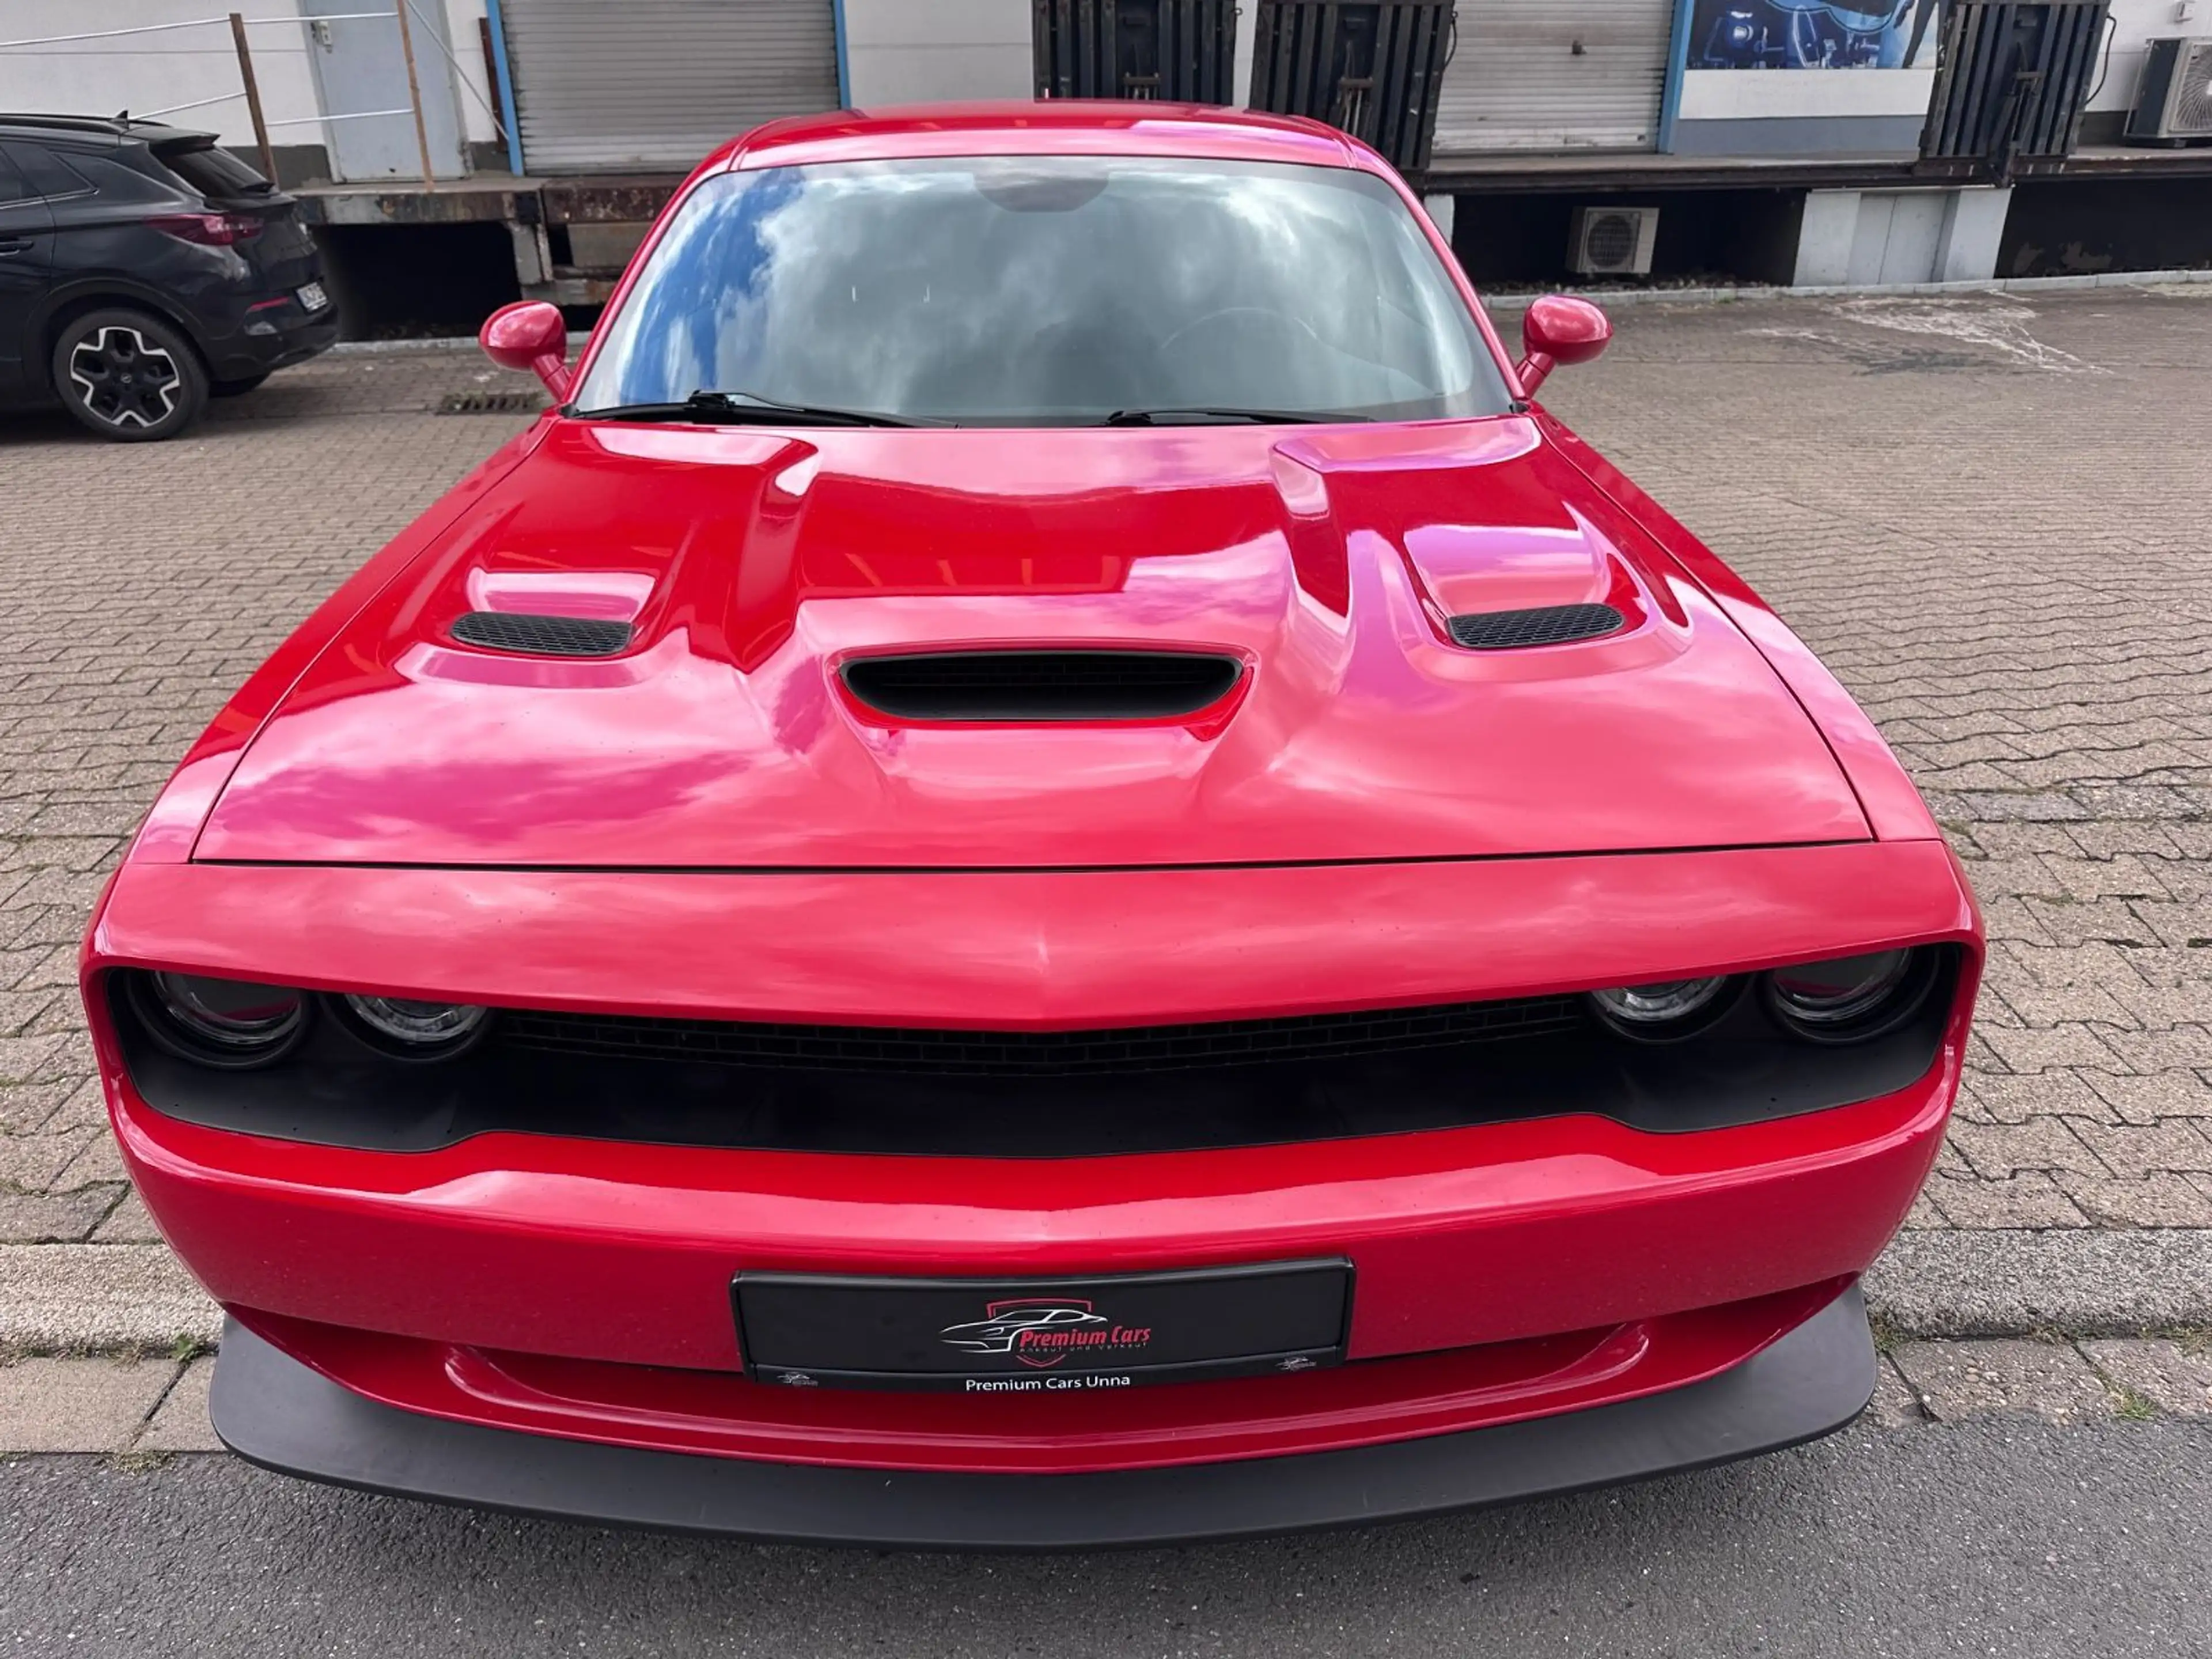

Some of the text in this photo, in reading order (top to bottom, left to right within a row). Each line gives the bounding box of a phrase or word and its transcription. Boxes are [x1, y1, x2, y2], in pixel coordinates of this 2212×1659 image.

[1019, 1325, 1151, 1347] Premium Cars
[965, 1375, 1131, 1391] Premium Cars Unna
